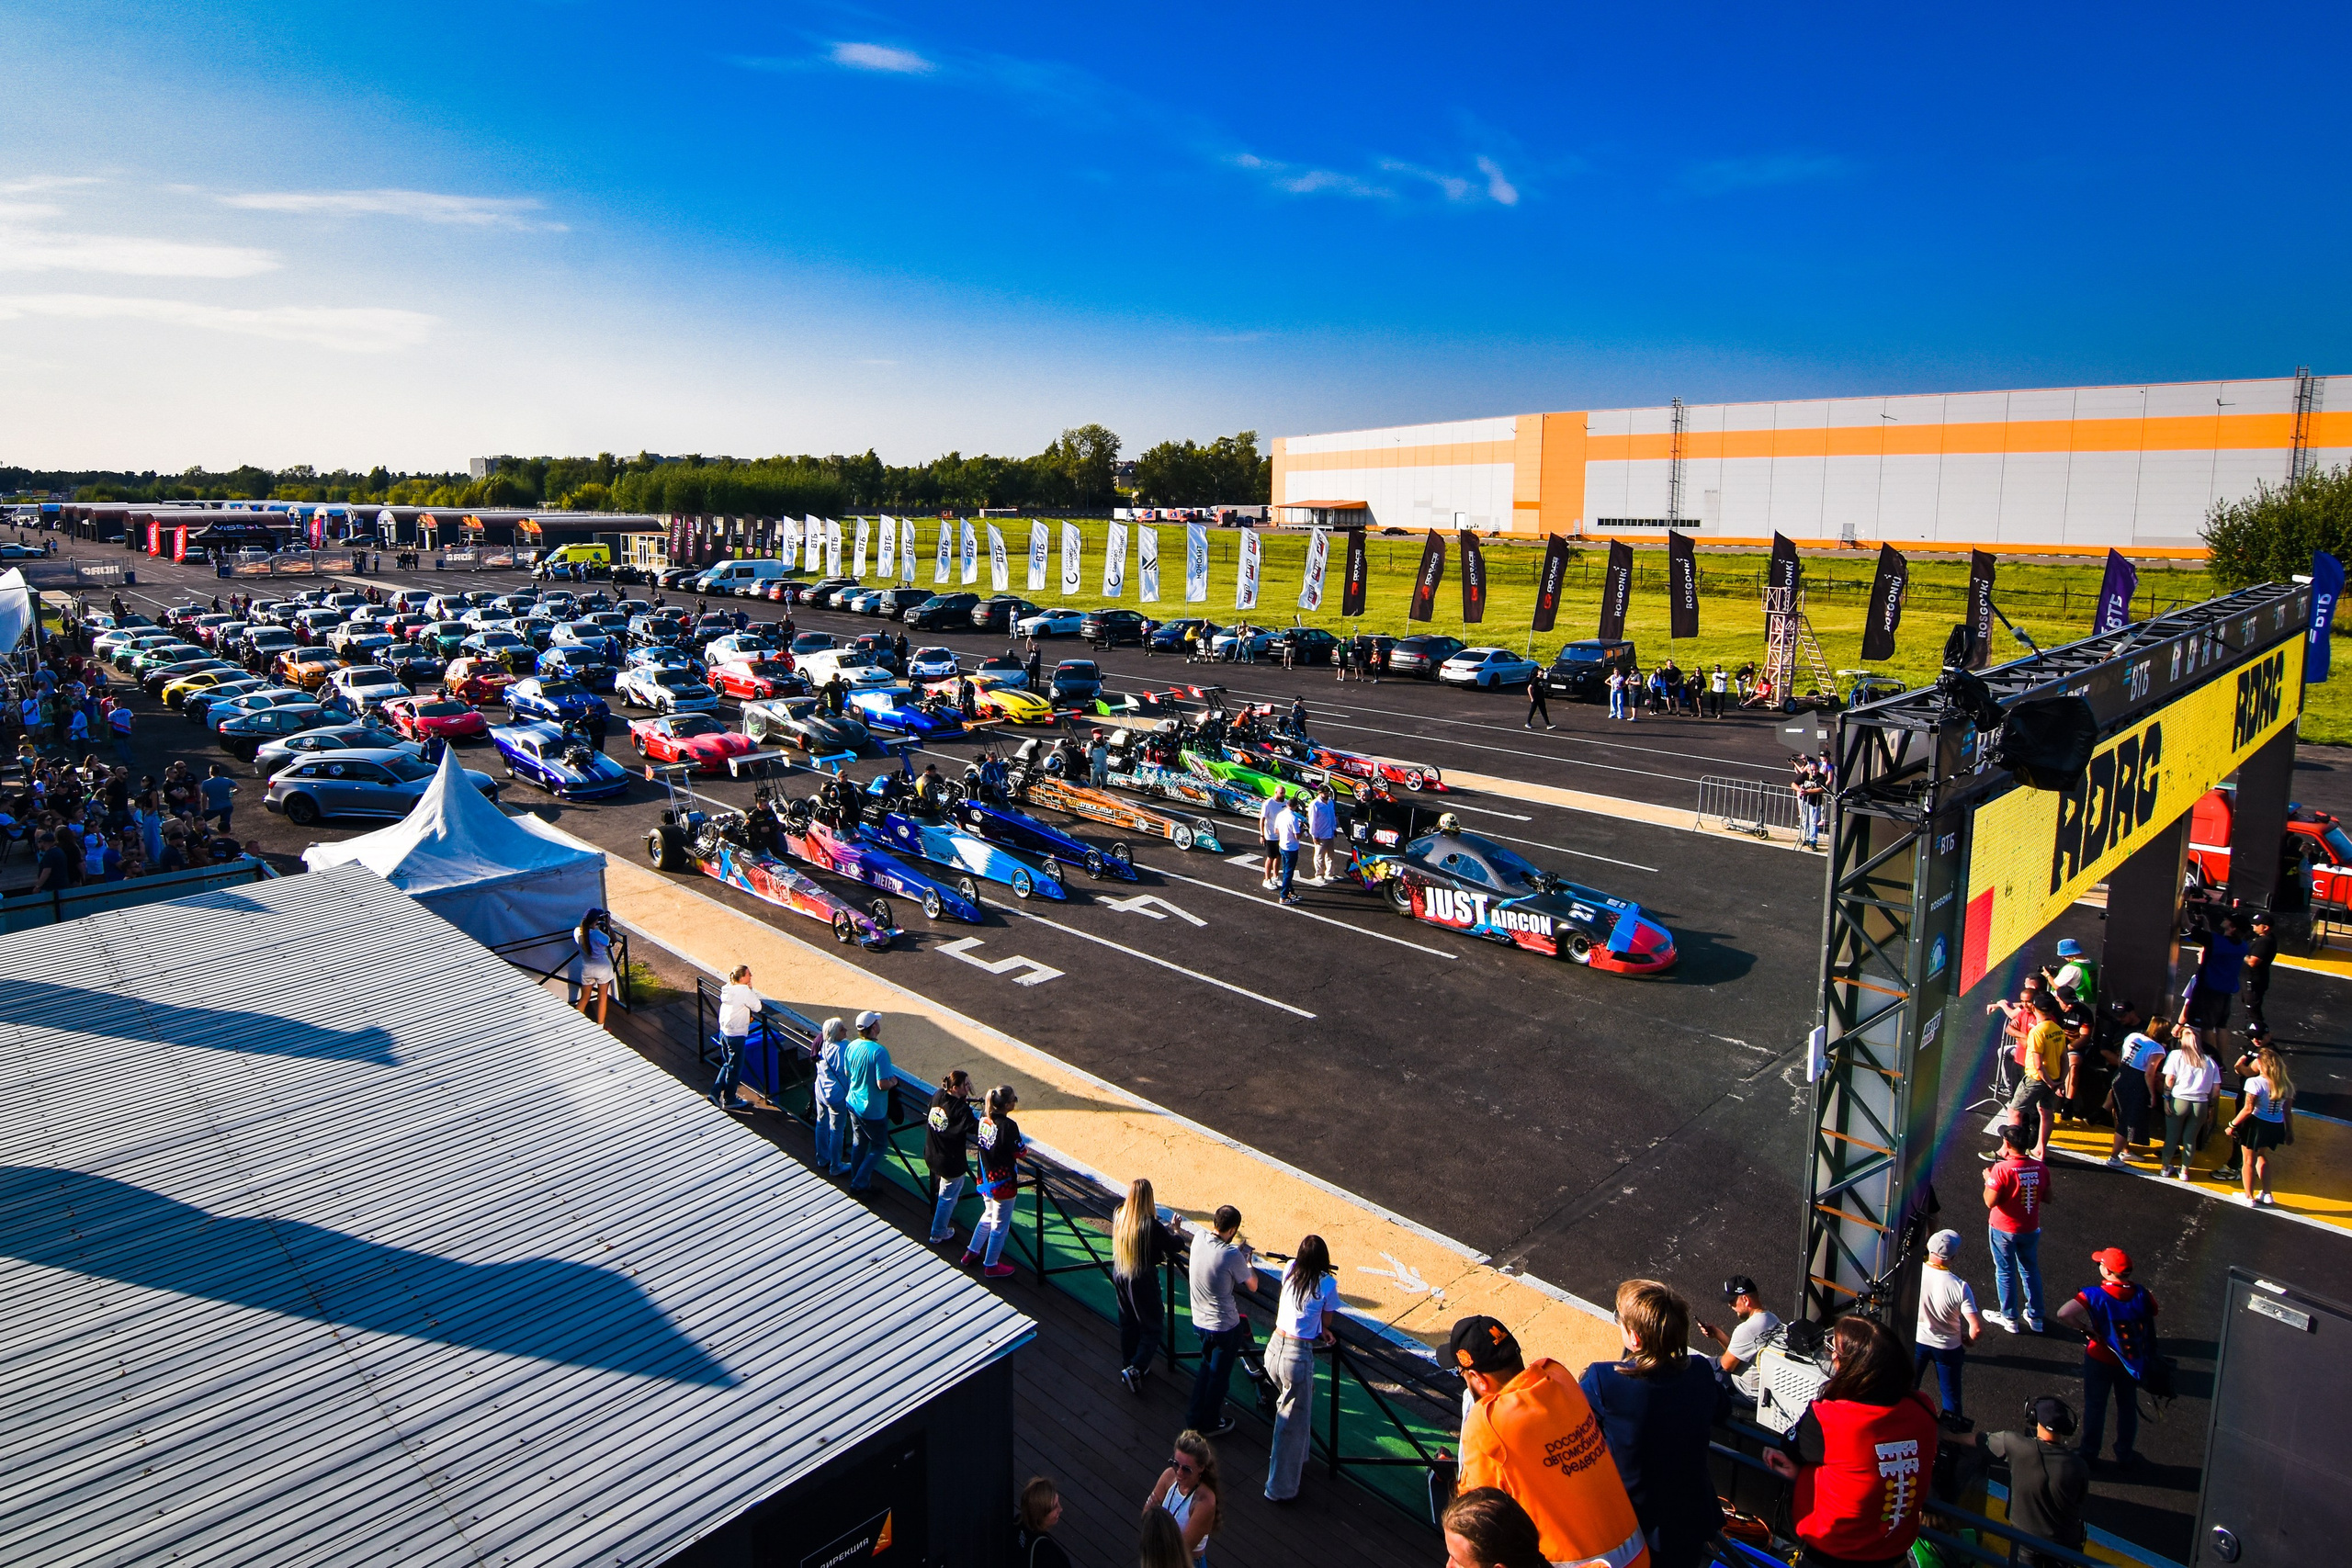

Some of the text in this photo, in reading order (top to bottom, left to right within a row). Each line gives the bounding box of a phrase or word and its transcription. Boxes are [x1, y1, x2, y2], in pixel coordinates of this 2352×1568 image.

[858, 536, 866, 552] ВТБ
[884, 535, 892, 551] ВТБ
[966, 539, 974, 558] ВТБ
[995, 545, 1003, 562] ВТБ
[1035, 543, 1045, 561] ВТБ
[1546, 557, 1558, 592] GO RACE
[1685, 558, 1693, 609] ROSGONKI
[1614, 568, 1627, 617] ROSGONKI
[1883, 576, 1902, 632] ROSGONKI
[1978, 580, 1989, 638] ROSGONKI
[2106, 593, 2123, 628] ВТБ
[2245, 616, 2257, 646] ВТБ
[2130, 660, 2151, 702] ВТБ
[2232, 650, 2284, 753] RDRC
[2050, 721, 2163, 897] RDRC
[1940, 832, 1955, 855] ВТБ
[1389, 864, 1404, 877] 27
[1095, 894, 1208, 927] 4
[1424, 886, 1554, 936] JUST AIRCON
[1567, 902, 1597, 922] 27
[1930, 891, 1953, 912] ROSGONKI
[933, 936, 1066, 987] 5
